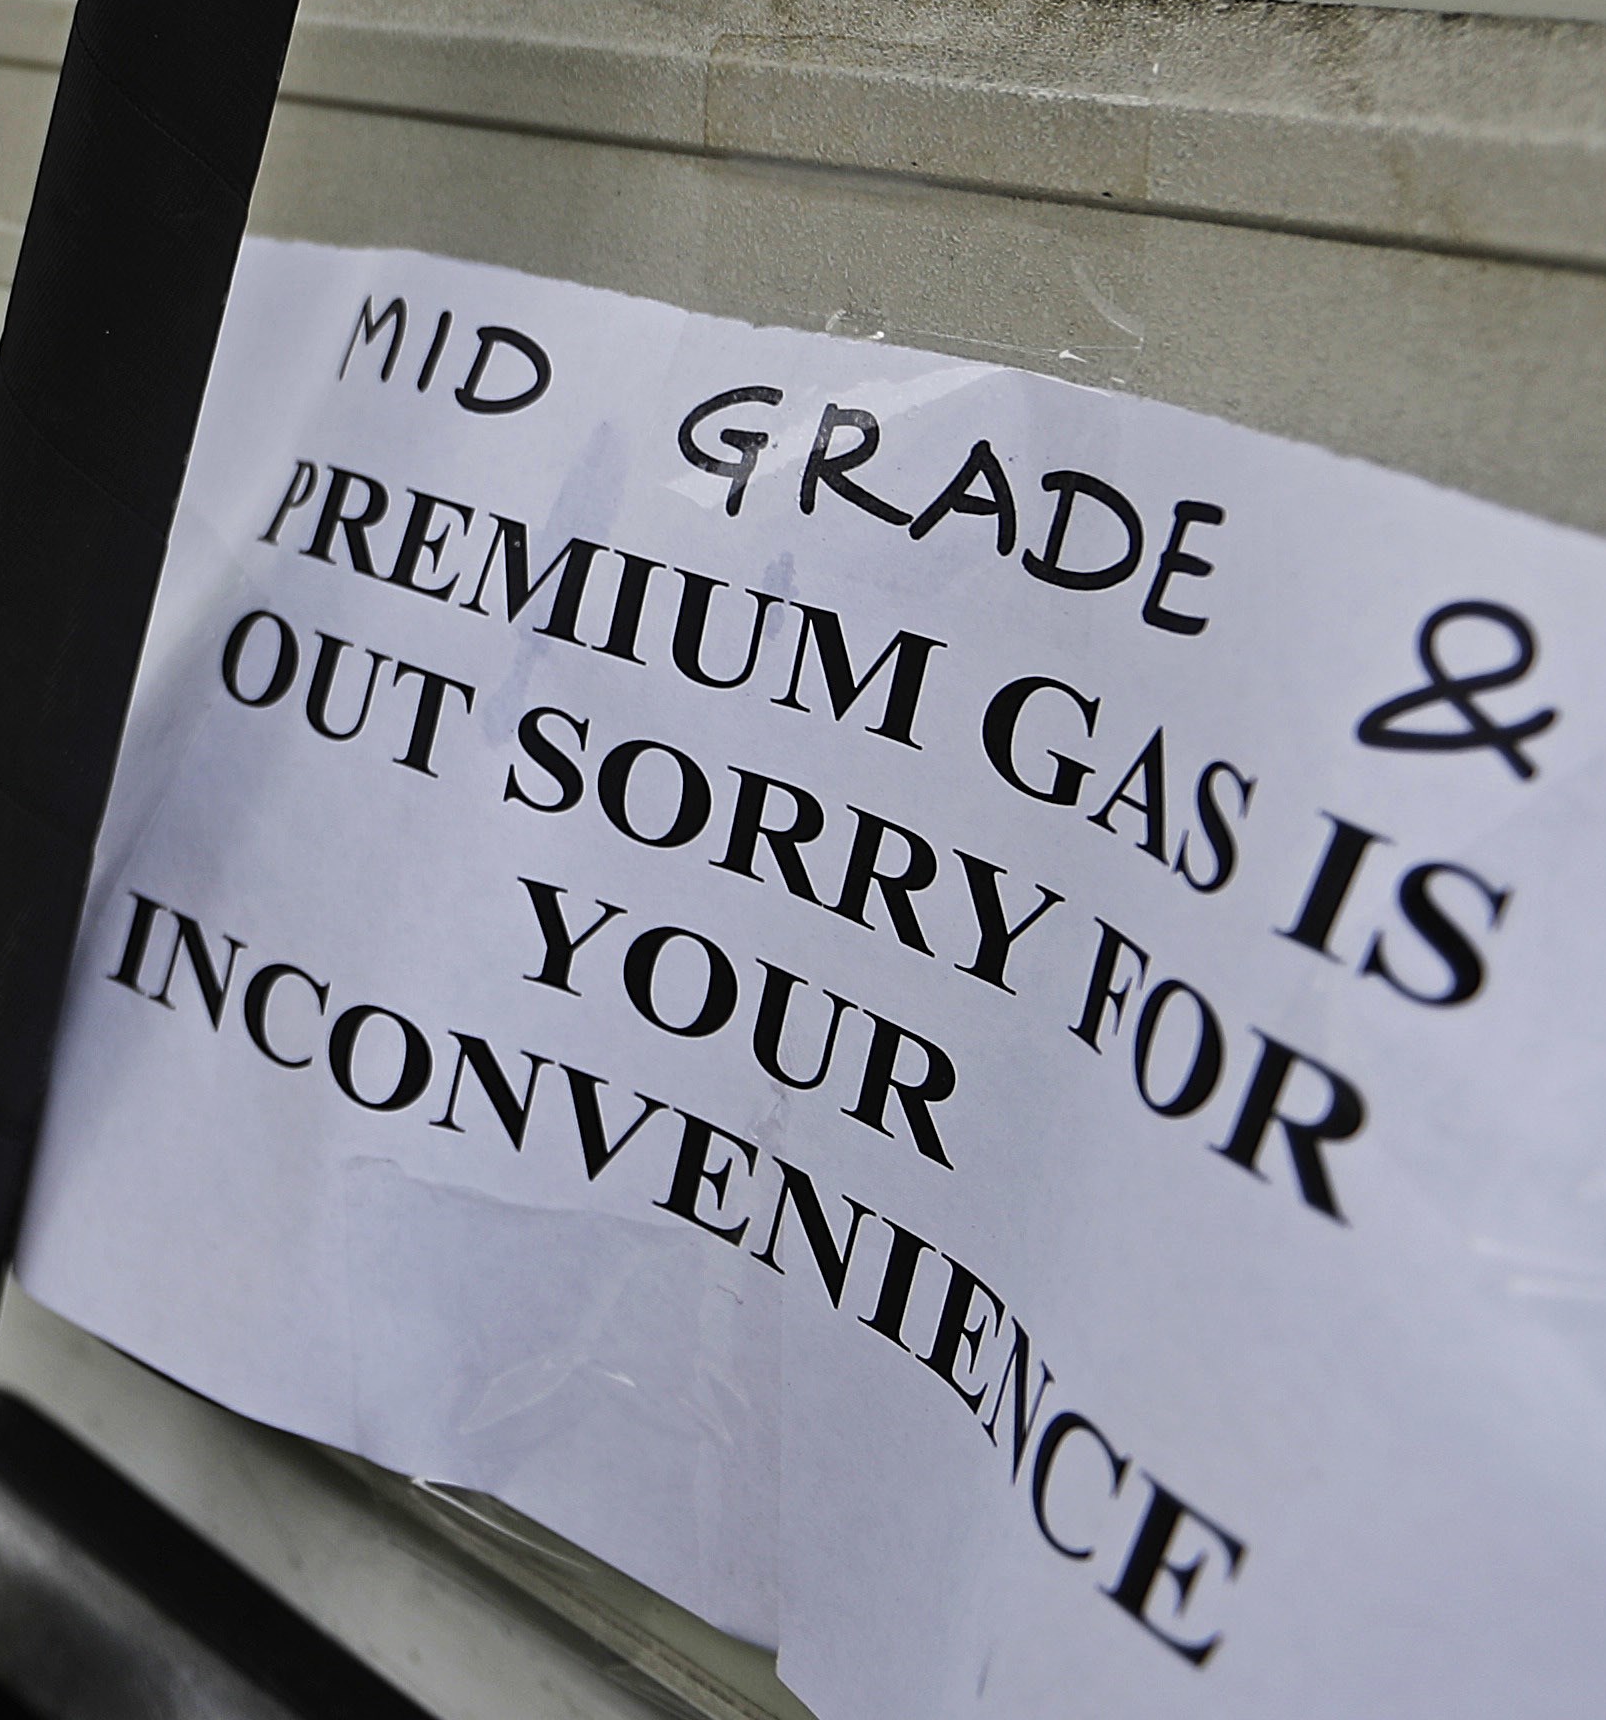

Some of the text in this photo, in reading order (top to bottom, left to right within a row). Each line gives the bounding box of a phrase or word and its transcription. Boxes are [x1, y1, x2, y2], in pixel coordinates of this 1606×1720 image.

[256, 459, 1513, 1009] PREMIUM GAS IS
[339, 294, 1560, 781] MID GRADE &
[219, 608, 1371, 1225] OUT SORRY FOR
[516, 875, 960, 1171] YOUR
[106, 890, 1251, 1671] INCONVENIENCE
